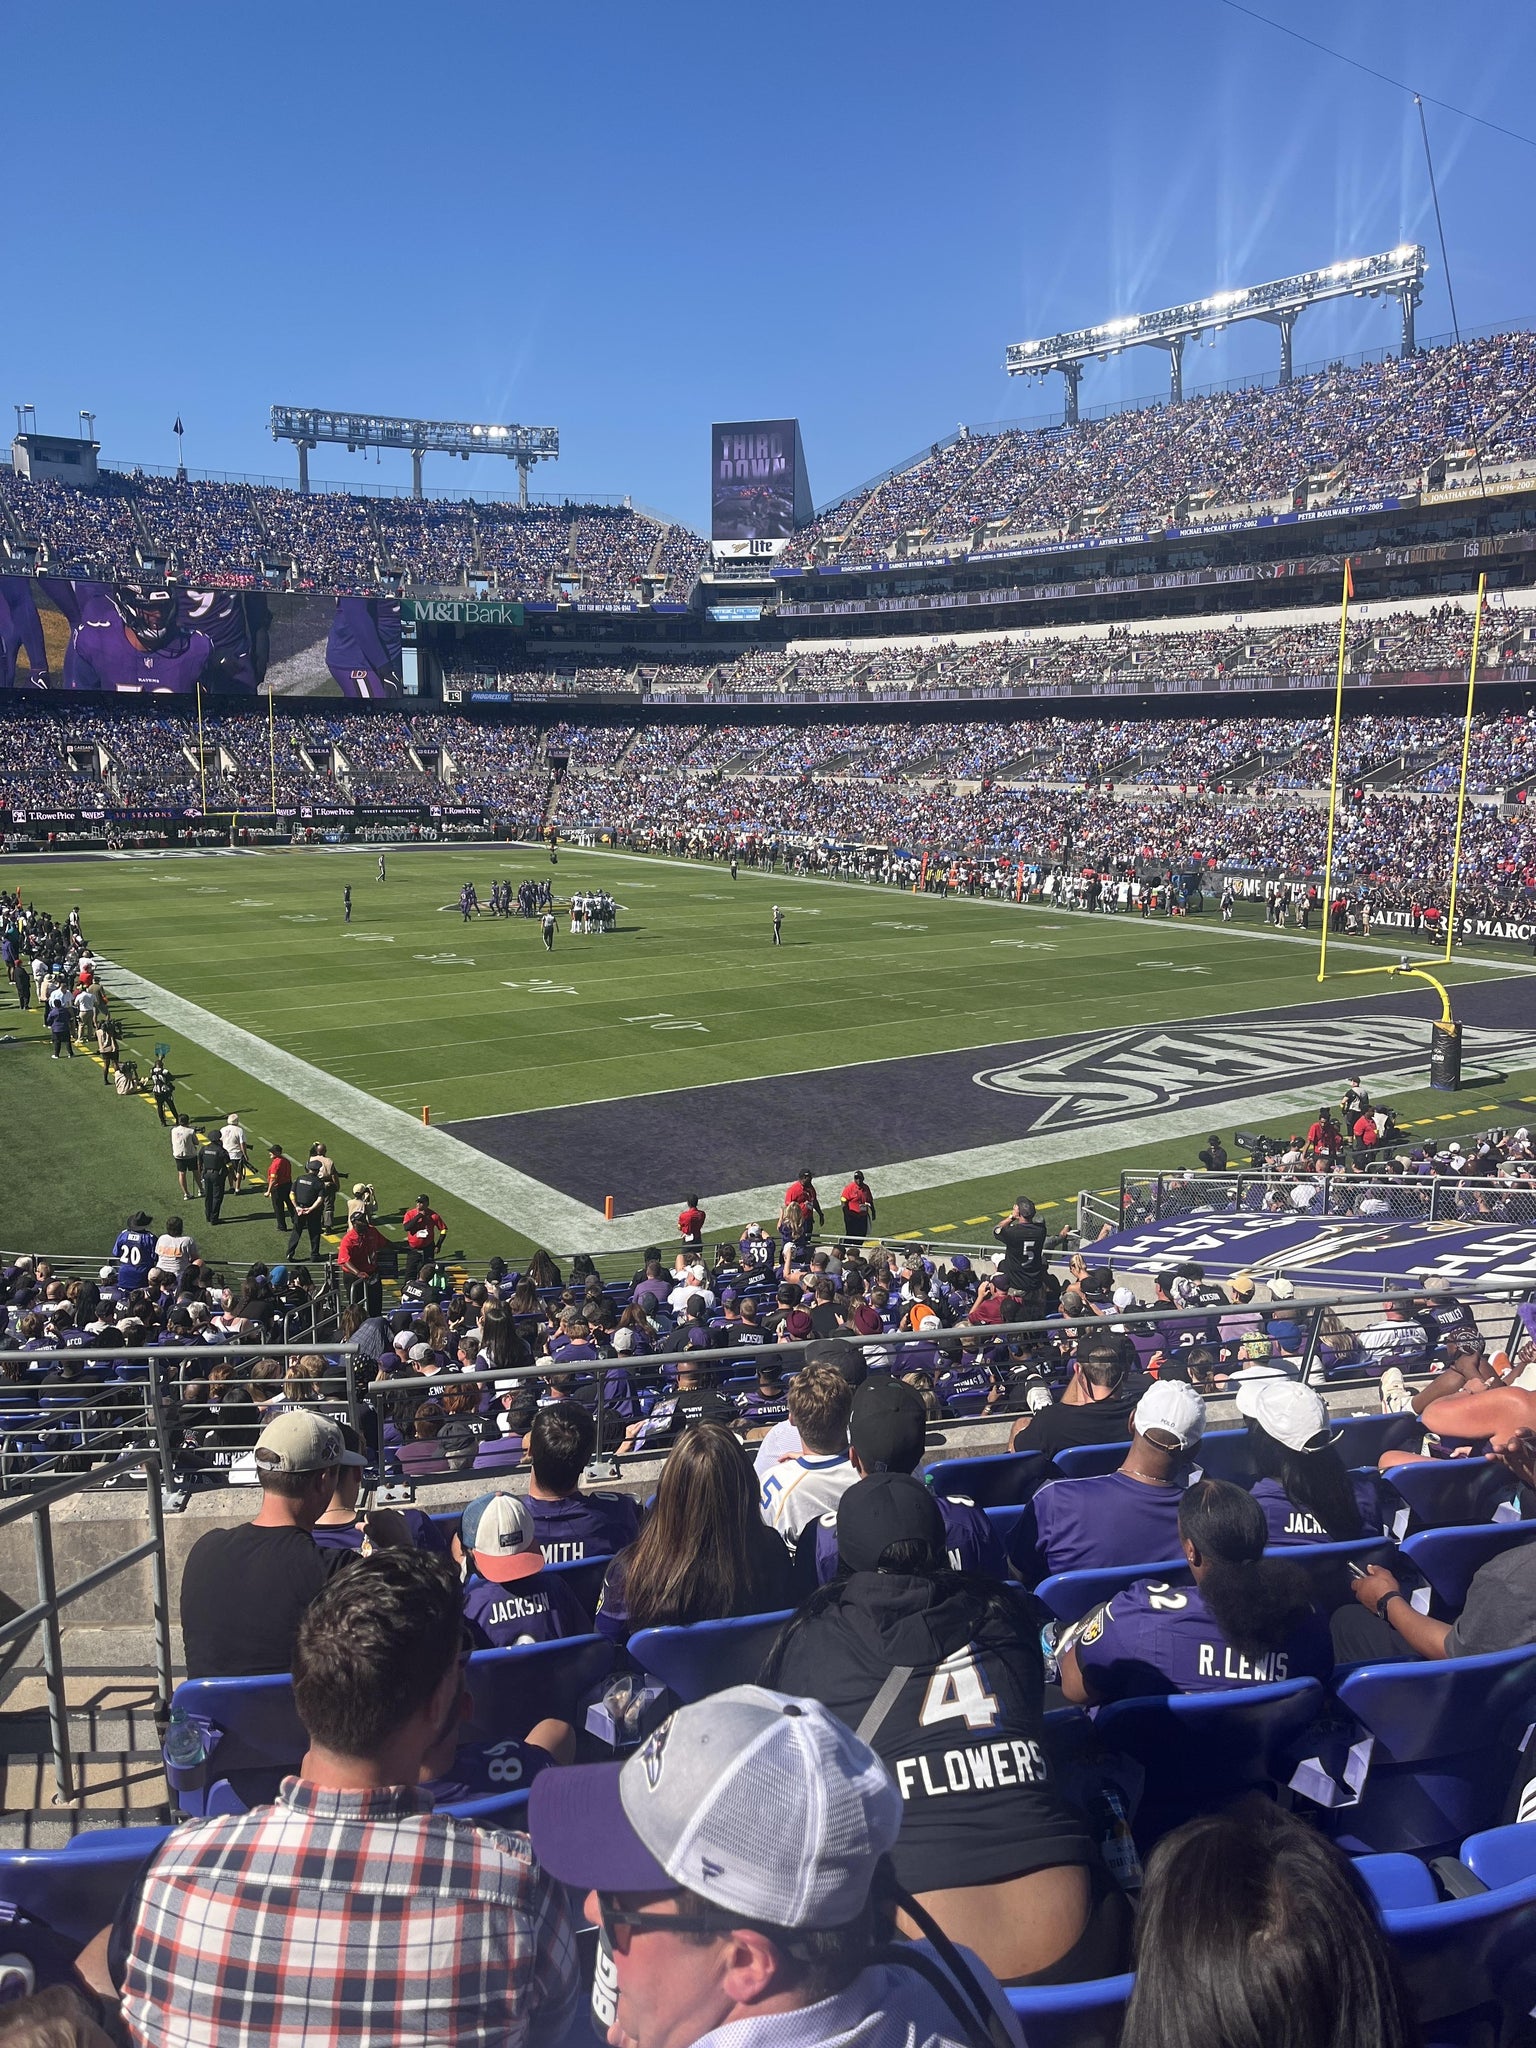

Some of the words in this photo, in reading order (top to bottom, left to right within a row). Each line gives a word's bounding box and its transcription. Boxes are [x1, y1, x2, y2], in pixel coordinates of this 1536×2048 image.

[721, 434, 783, 459] THIRD
[720, 457, 785, 479] DOWN
[1430, 490, 1467, 503] JONATHAN
[1496, 482, 1535, 492] 1996-2007
[1298, 512, 1316, 521] PETER
[1317, 508, 1350, 519] BOULWARE
[1351, 502, 1383, 513] 1997-2005
[1180, 527, 1202, 536] MICHAEL
[749, 540, 772, 556] Lite
[1463, 544, 1479, 557] 1:56
[413, 601, 464, 622] M&T
[465, 603, 513, 624] Bank
[1223, 876, 1262, 898] HME
[500, 978, 580, 996] 20
[619, 1012, 711, 1033] 10
[120, 1244, 141, 1265] 20
[1023, 1240, 1036, 1267] 5
[1200, 1291, 1221, 1302] ACKSON
[738, 1332, 764, 1345] JACKSON
[1160, 1418, 1176, 1429] POLO
[540, 1541, 584, 1565] MITH
[488, 1591, 550, 1625] JACKSON
[1199, 1643, 1289, 1682] R.LEWIS
[918, 1646, 1000, 1731] 4
[896, 1739, 1048, 1800] FLOWERS
